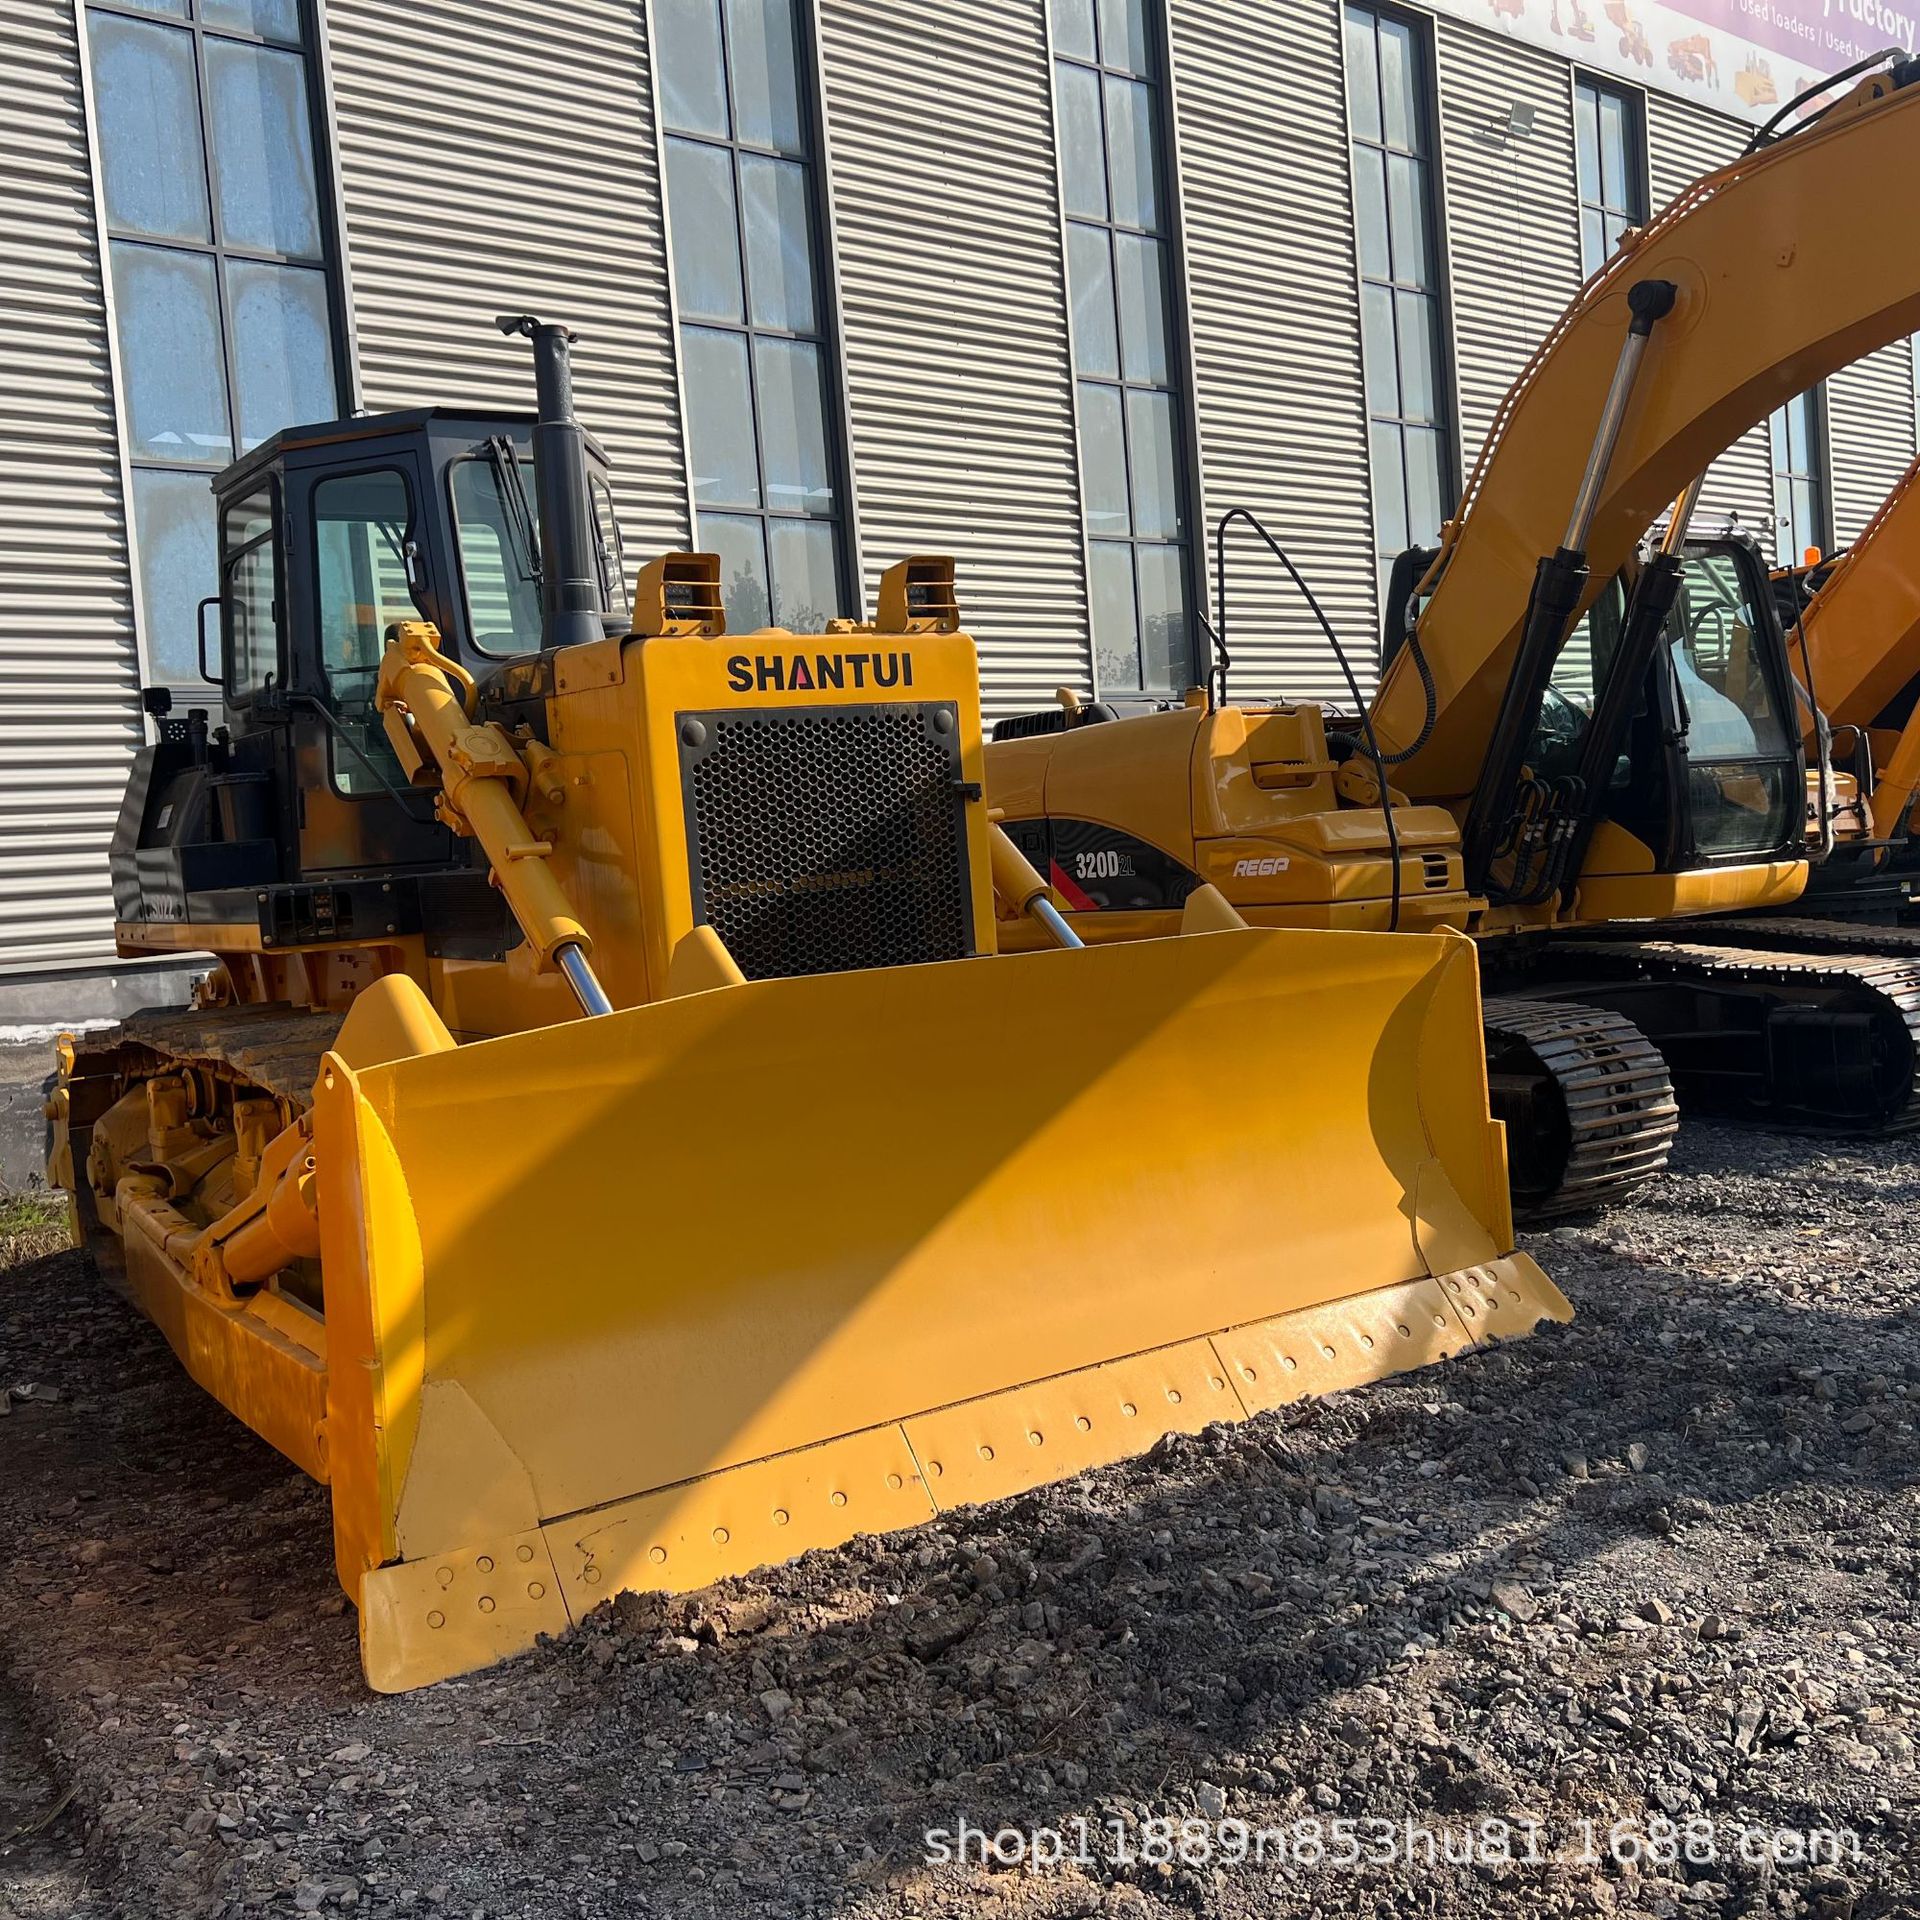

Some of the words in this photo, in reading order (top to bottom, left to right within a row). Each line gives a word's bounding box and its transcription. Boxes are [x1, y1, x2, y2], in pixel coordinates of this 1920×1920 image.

[1740, 0, 1768, 21] Used
[1772, 5, 1816, 42] loaders
[1825, 31, 1852, 57] Used
[727, 652, 914, 692] SHANTUI
[1232, 857, 1290, 878] REGP
